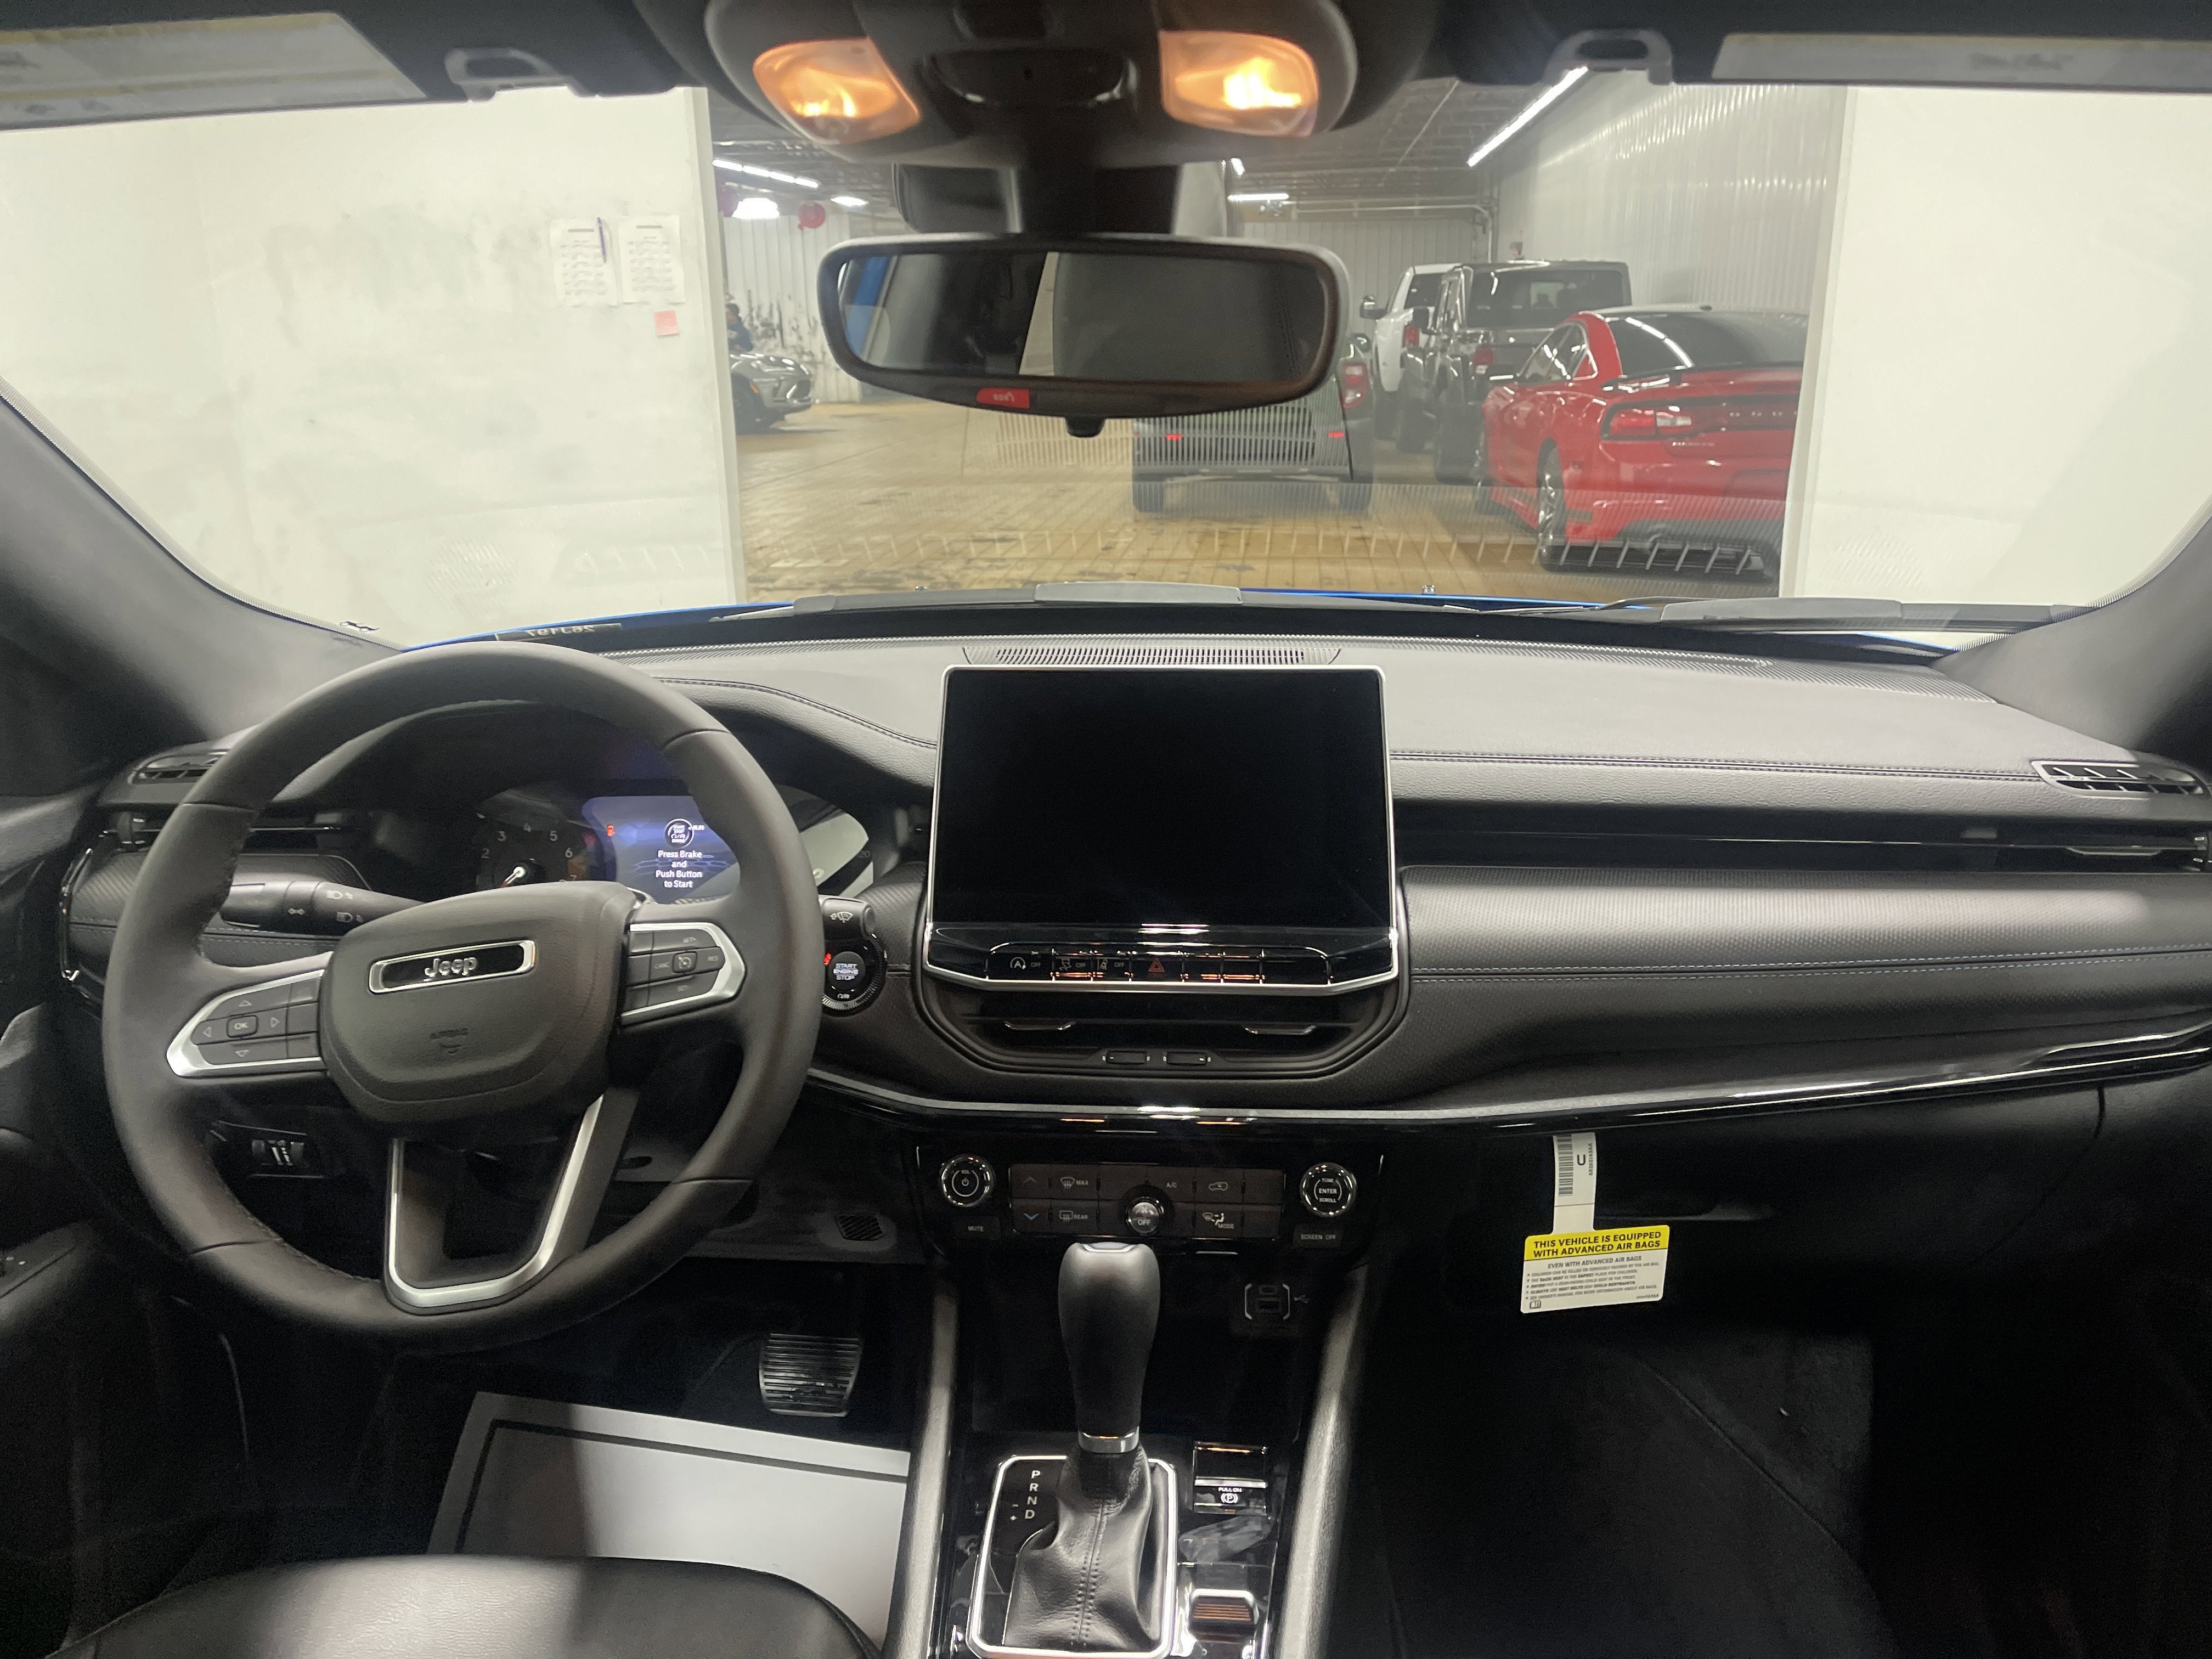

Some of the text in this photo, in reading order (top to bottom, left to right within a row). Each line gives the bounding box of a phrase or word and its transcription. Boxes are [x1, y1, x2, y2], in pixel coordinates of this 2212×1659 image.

[523, 823, 532, 832] 4
[497, 831, 506, 842] 3
[550, 830, 558, 842] 5
[481, 848, 490, 859] 2
[565, 848, 573, 858] 6
[658, 850, 703, 858] Press Brake
[671, 860, 687, 868] and
[655, 870, 675, 878] Push
[673, 879, 693, 888] Start
[424, 957, 478, 978] Jeep
[1577, 1154, 1586, 1166] U
[1534, 1240, 1556, 1248] THIS
[1559, 1236, 1599, 1246] VEHICLE
[1613, 1231, 1661, 1242] EQUIPPED
[1533, 1248, 1558, 1257] WITH
[1561, 1244, 1613, 1255] ADVANCED
[1031, 1470, 1041, 1479] P
[1029, 1483, 1039, 1492] R
[1027, 1496, 1037, 1505] N
[1024, 1509, 1035, 1520] D
